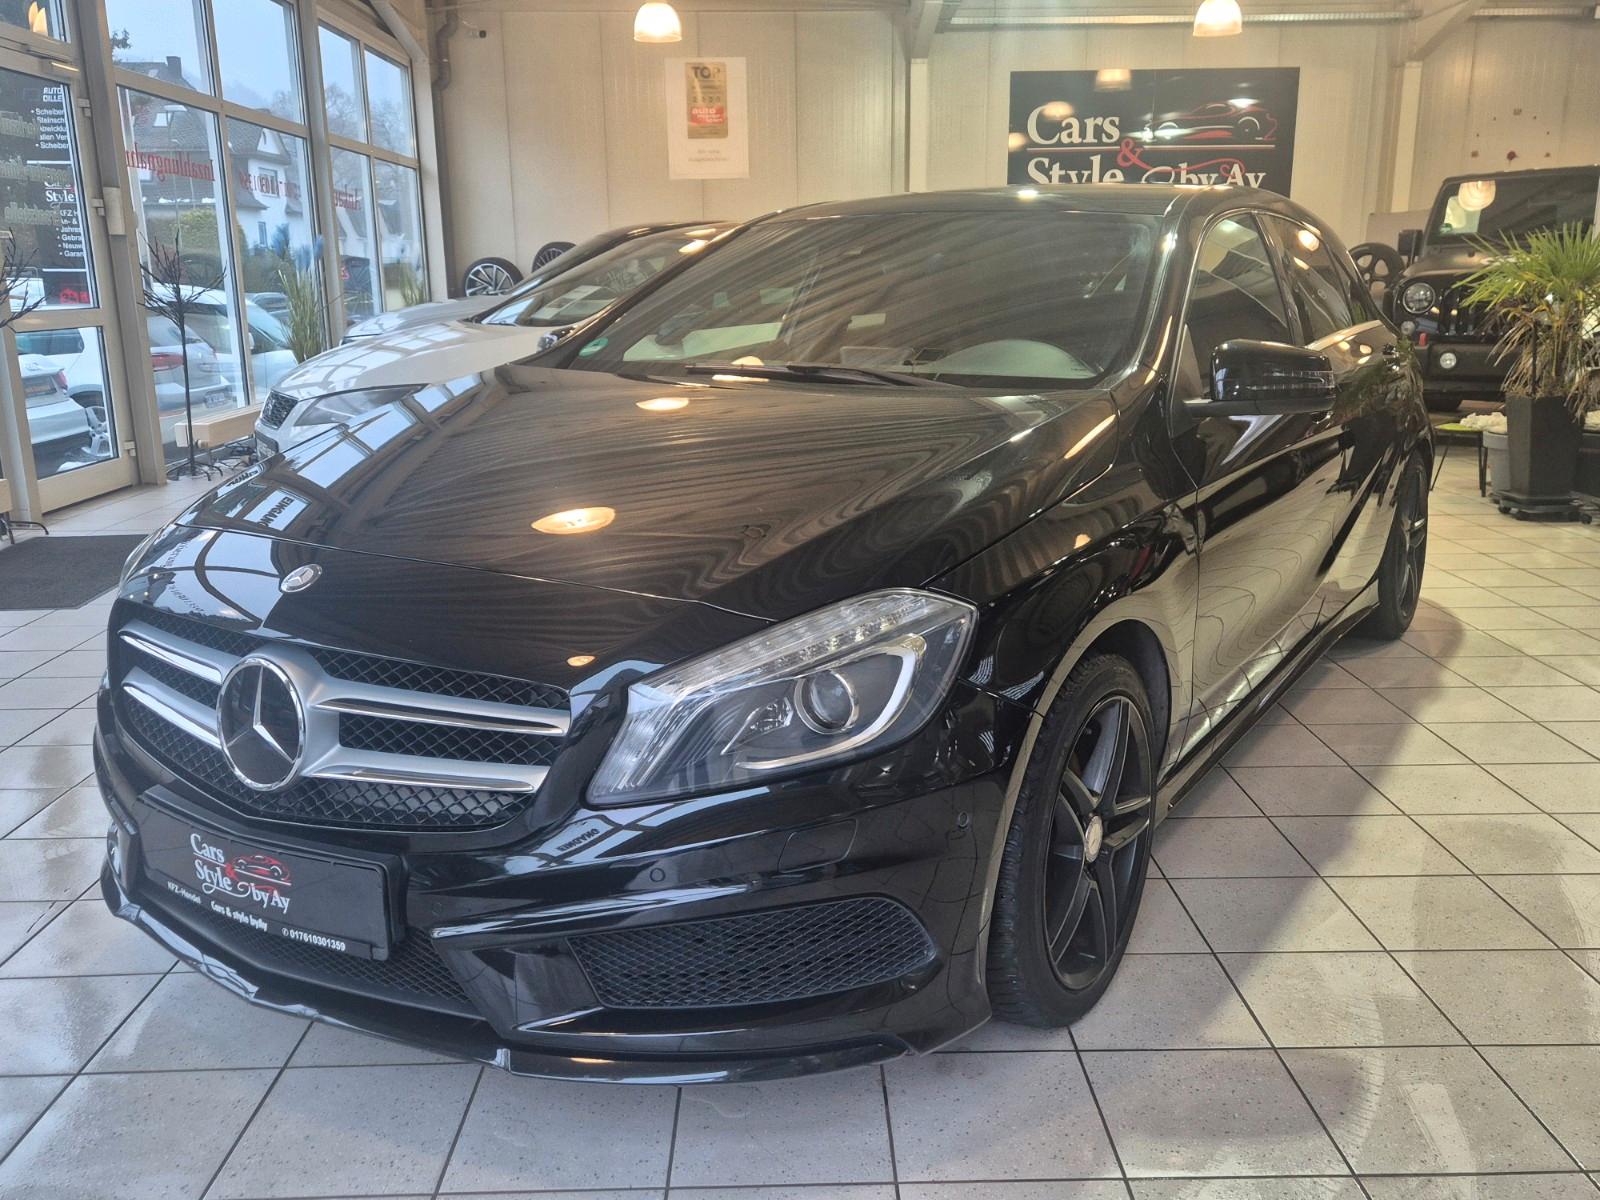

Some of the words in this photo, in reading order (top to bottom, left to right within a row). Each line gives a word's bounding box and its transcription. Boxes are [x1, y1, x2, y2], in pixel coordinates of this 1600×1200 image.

[1027, 105, 1120, 145] Cars
[190, 833, 225, 864] Cars
[194, 859, 240, 896] Style
[250, 883, 269, 909] by
[271, 889, 291, 914] Ay
[210, 900, 226, 915] Cars
[289, 929, 346, 952] 017610301359
